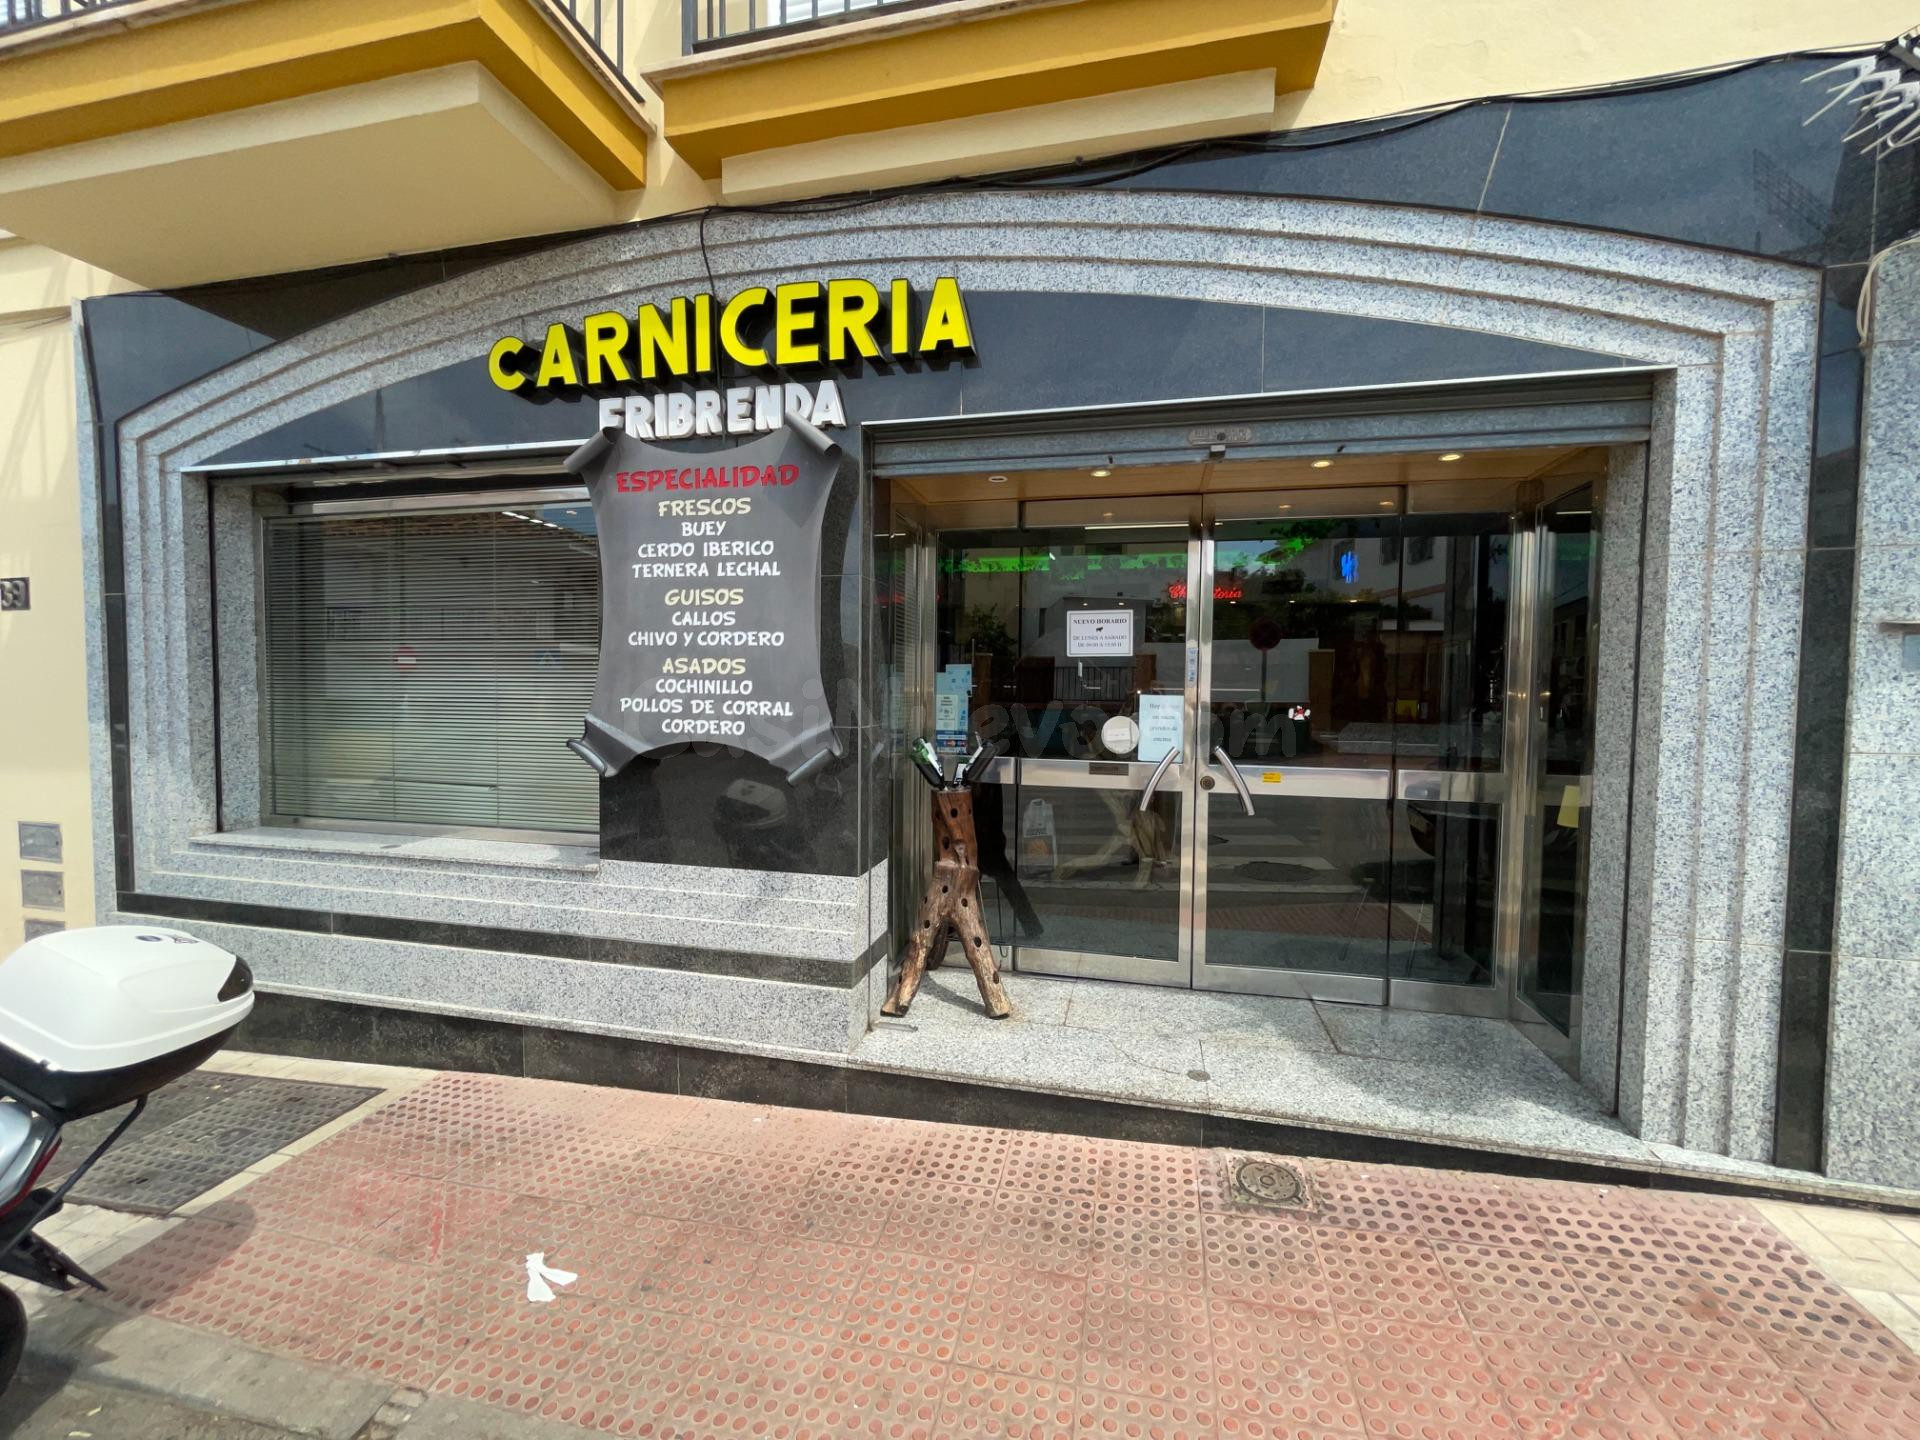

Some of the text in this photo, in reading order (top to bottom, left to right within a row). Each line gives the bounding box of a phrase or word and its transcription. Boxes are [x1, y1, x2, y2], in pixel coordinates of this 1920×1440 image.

[488, 276, 973, 391] CARNICERIA
[598, 379, 847, 440] FRIBRENDA
[615, 463, 800, 494] ESPECIALIDAD
[658, 496, 752, 517] FRESCOS
[680, 520, 727, 537] BUEY
[637, 539, 775, 559] CERDO IBERICO
[631, 560, 781, 579] TERNERA LECHAL
[664, 587, 745, 606] GUISOS
[671, 610, 736, 627] CALLOS
[627, 630, 785, 648] CHIVO Y CORDERO
[662, 657, 747, 676] ASADOS
[655, 678, 753, 696] COCHINILLO
[619, 697, 794, 718] POLLOS DE CORRAL
[661, 718, 746, 736] CORDERO
